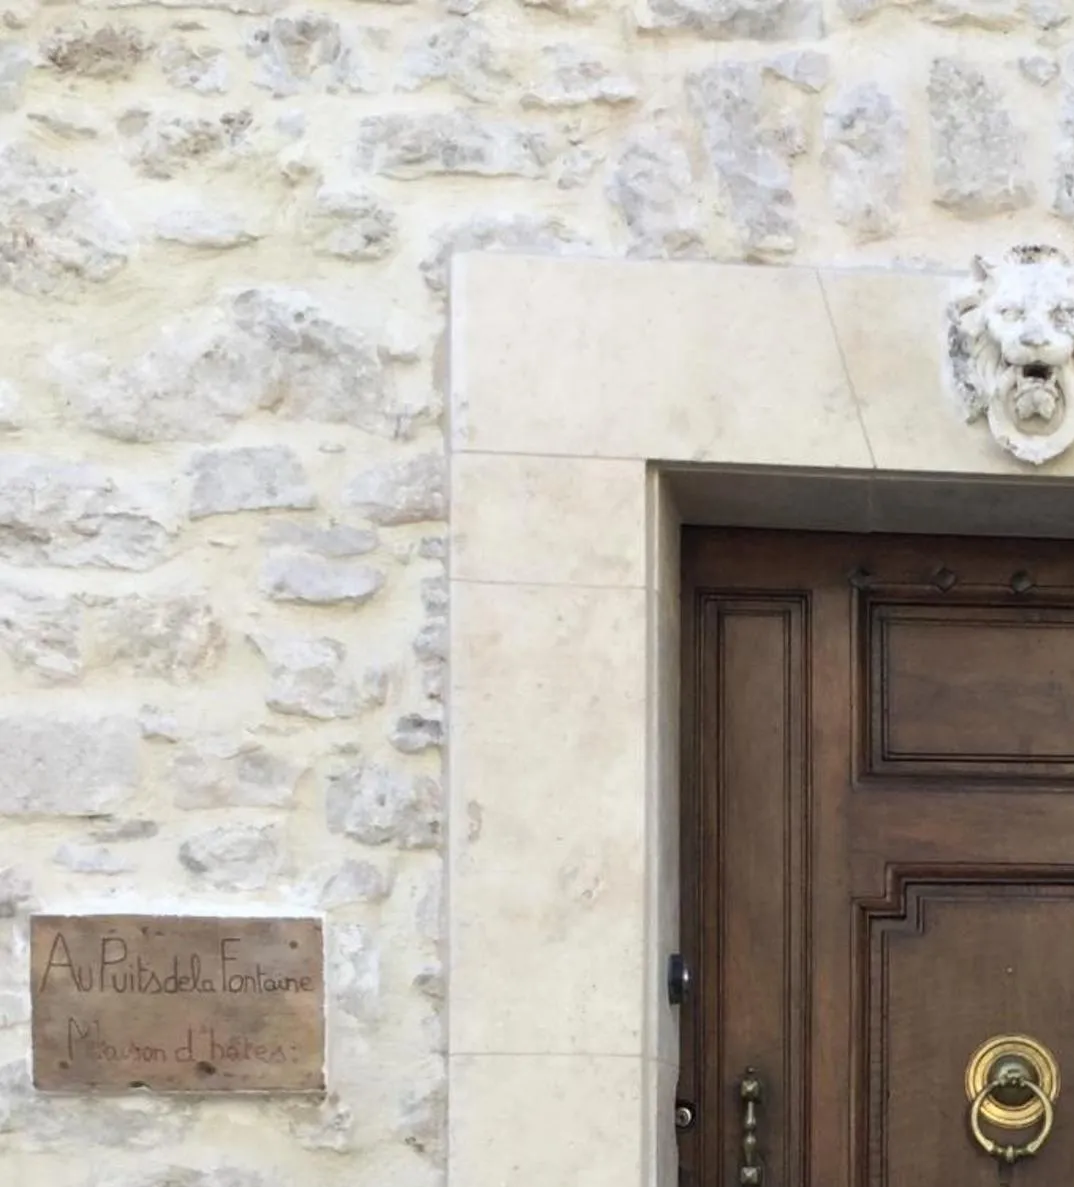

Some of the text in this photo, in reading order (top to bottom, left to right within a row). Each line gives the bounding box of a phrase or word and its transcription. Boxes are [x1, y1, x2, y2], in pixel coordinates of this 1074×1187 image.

[39, 931, 93, 992] Au
[100, 937, 163, 993] Puits
[221, 937, 315, 994] Fontaine
